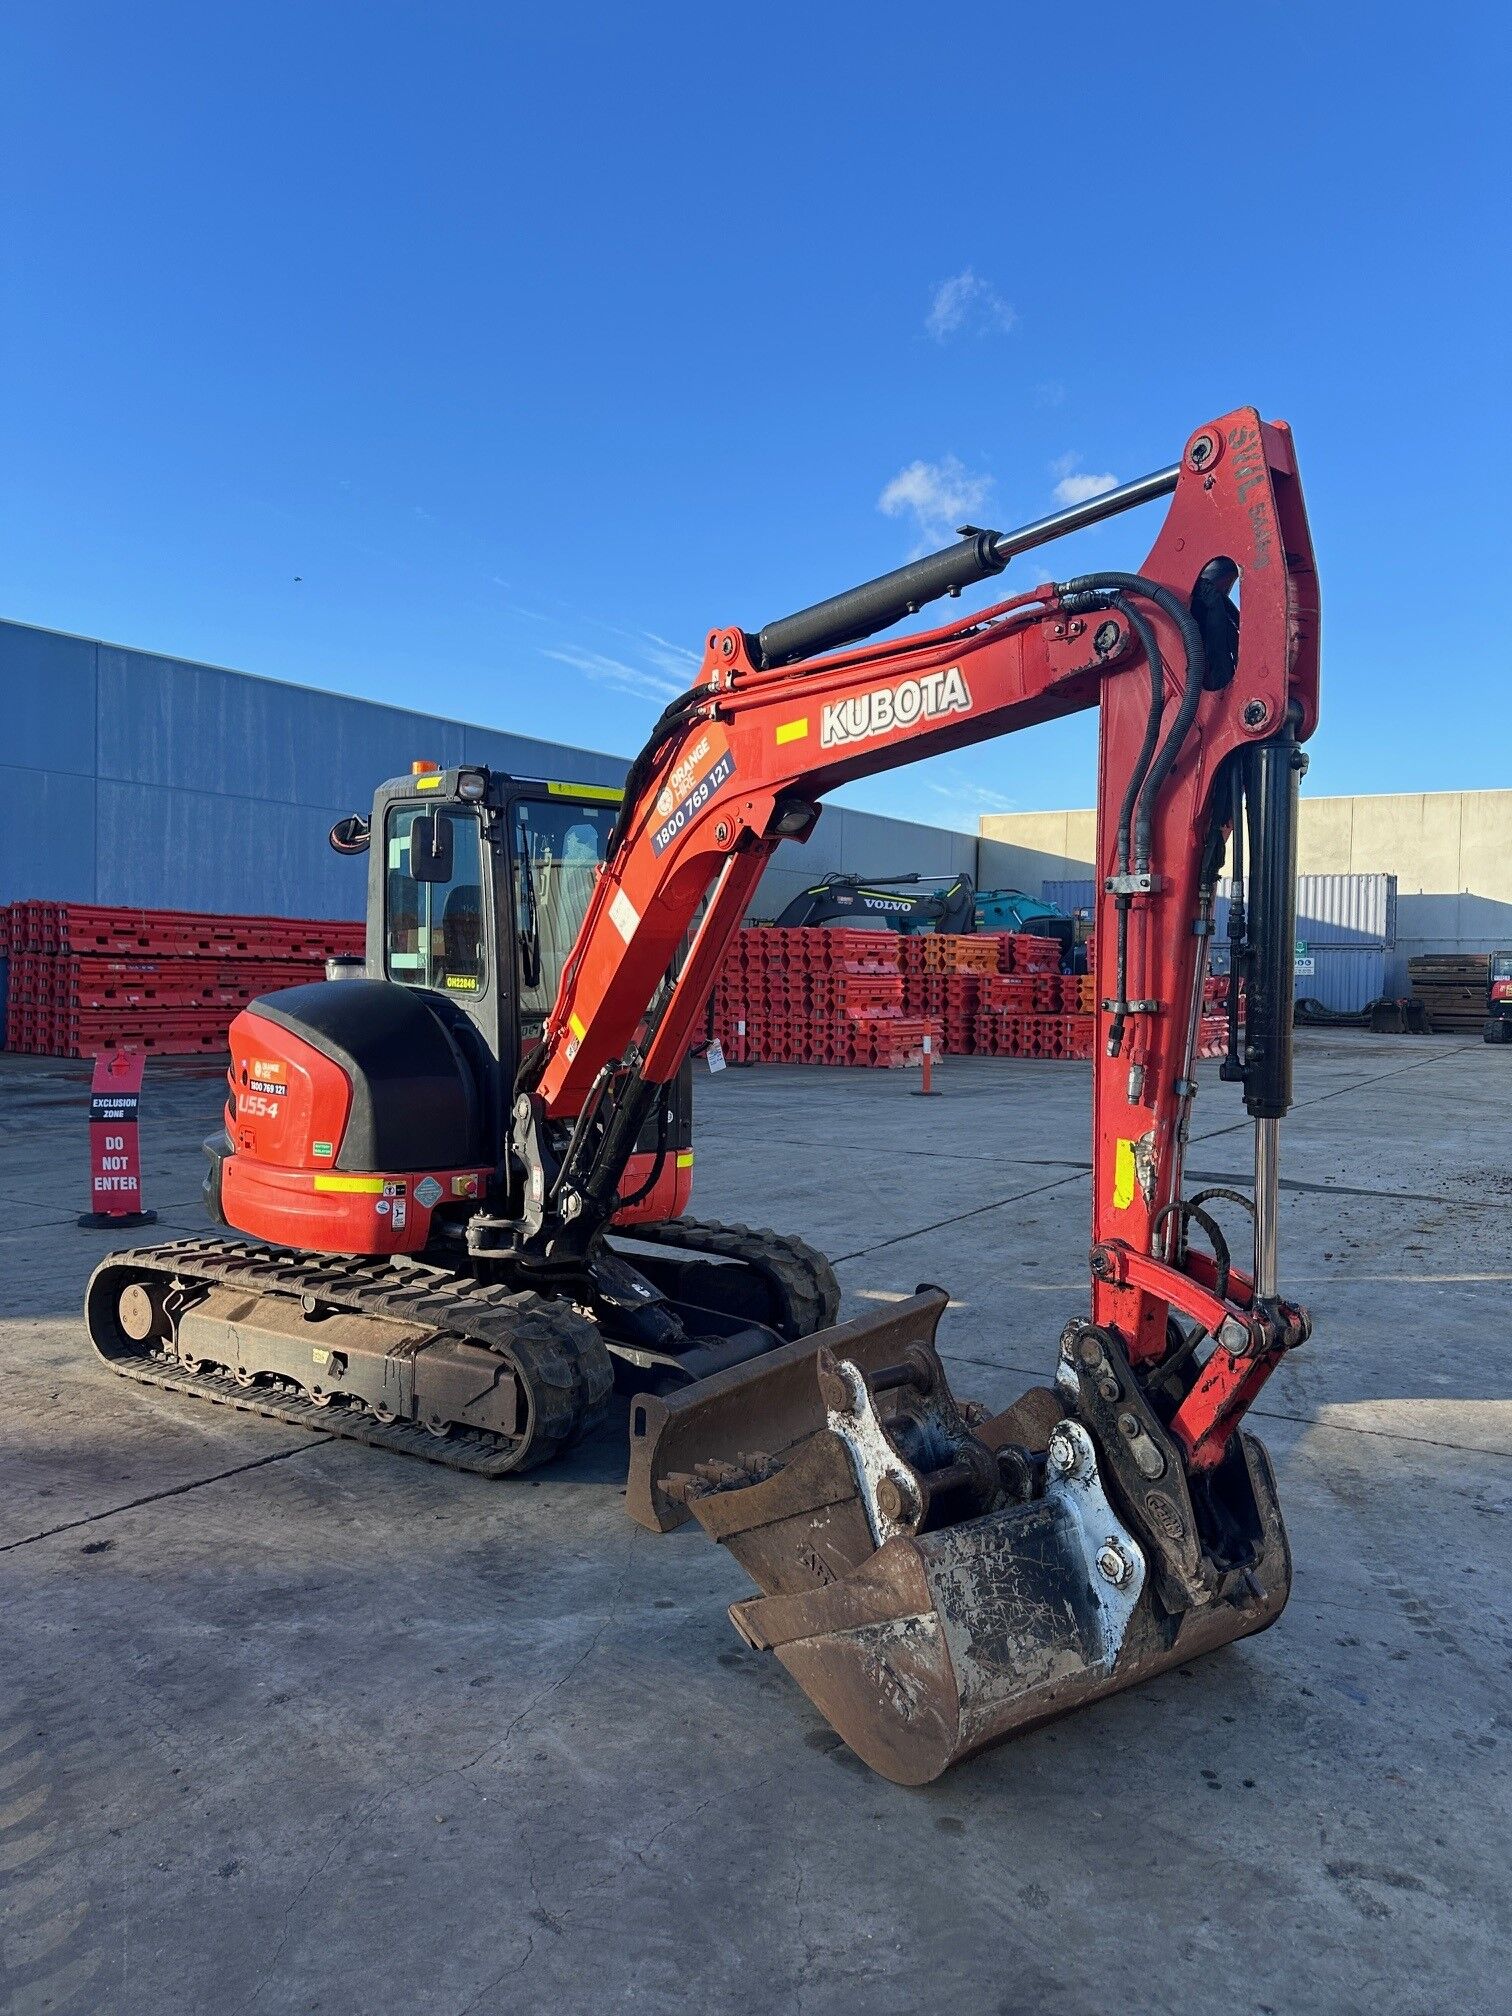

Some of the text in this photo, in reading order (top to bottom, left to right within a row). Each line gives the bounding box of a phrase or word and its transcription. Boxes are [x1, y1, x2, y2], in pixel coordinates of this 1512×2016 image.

[823, 667, 969, 744] KUBOTA
[671, 737, 710, 787] ORANGE
[675, 770, 696, 801] HIRE
[656, 759, 730, 848] 1800 769 121
[864, 899, 911, 912] VOLVO
[250, 1081, 285, 1095] 1800 769 121
[93, 1099, 137, 1107] EXCLUSION
[239, 1094, 278, 1118] U55-4
[106, 1137, 124, 1150] DO
[102, 1157, 128, 1170] NOT
[94, 1177, 138, 1190] ENTER
